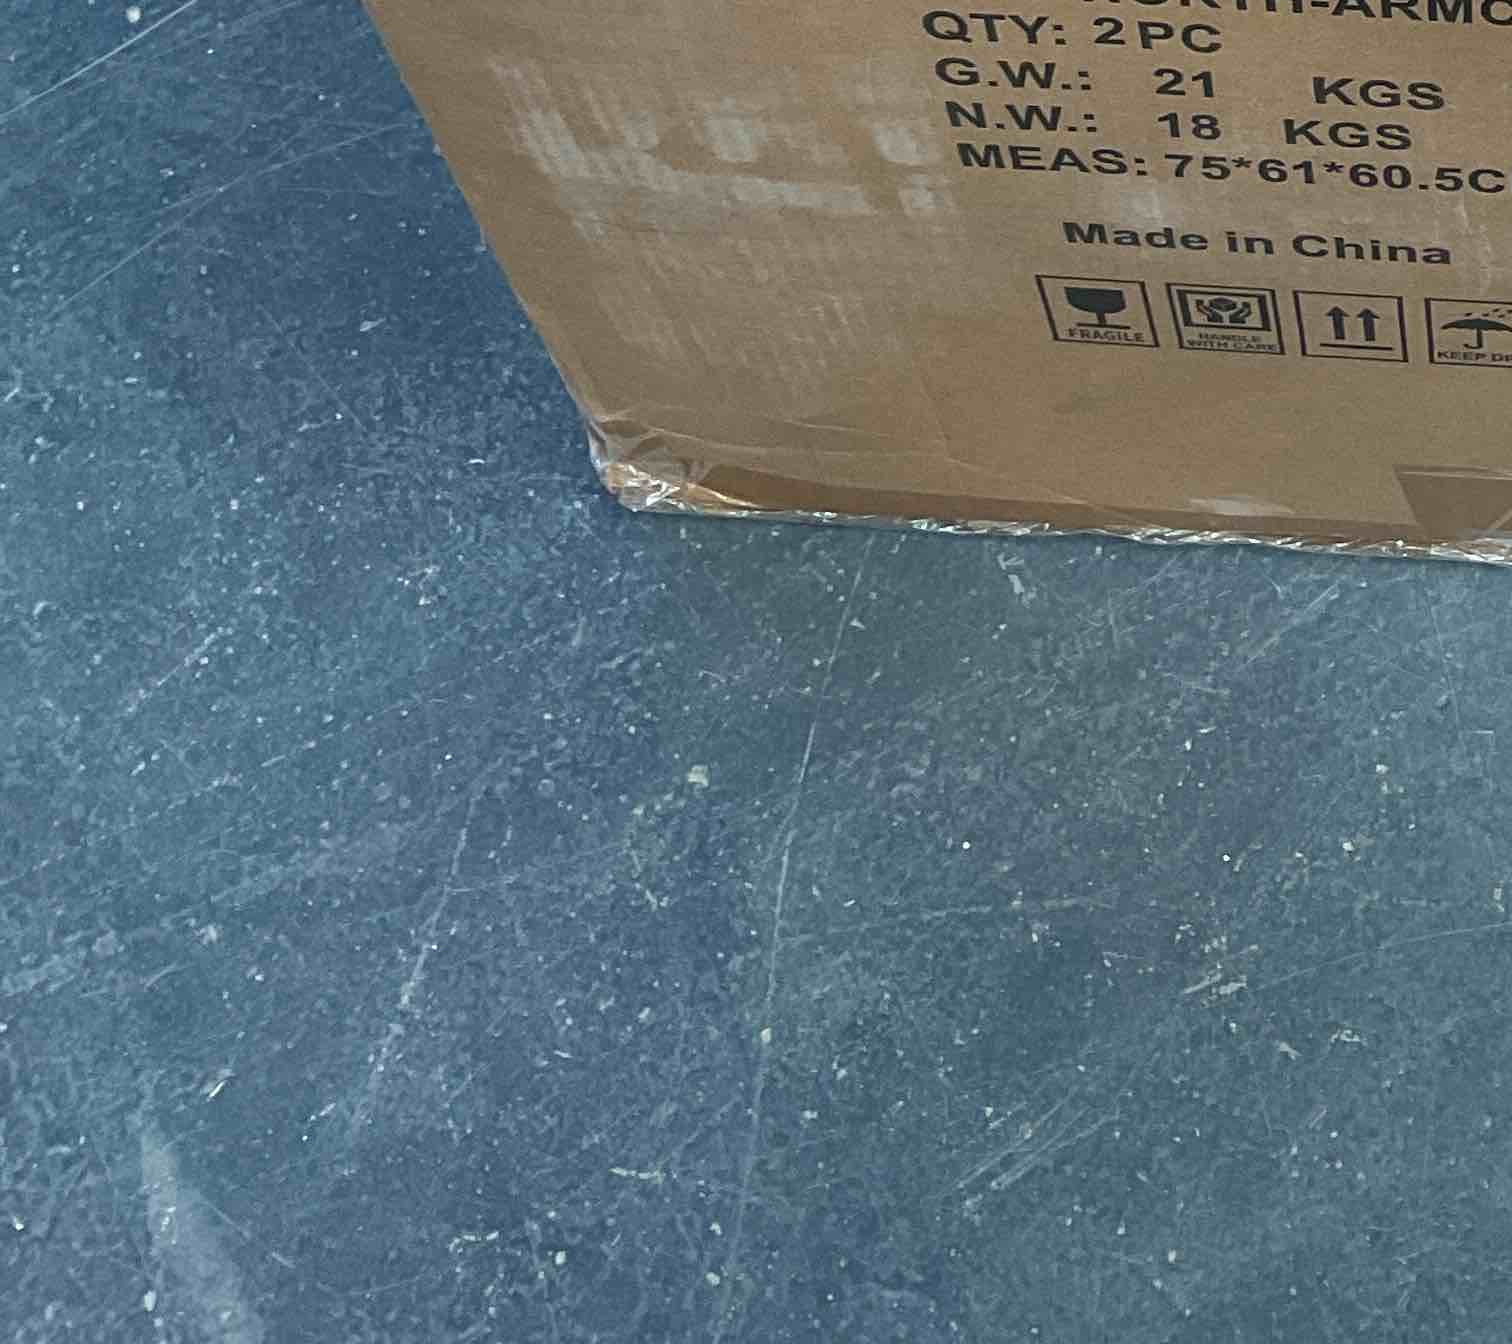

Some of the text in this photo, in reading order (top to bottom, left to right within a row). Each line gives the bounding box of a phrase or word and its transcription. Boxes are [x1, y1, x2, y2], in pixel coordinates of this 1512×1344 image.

[921, 9, 1068, 47] QTY:
[934, 56, 1446, 112] G.W.: 21 KGS
[944, 100, 1413, 151] N.W.: 18 KGS
[1061, 221, 1452, 266] Made in China
[1068, 327, 1145, 343] FRAGILE
[1187, 338, 1279, 353] WITH CARE
[1198, 332, 1263, 345] HANDLE
[1437, 350, 1488, 362] KEEP
